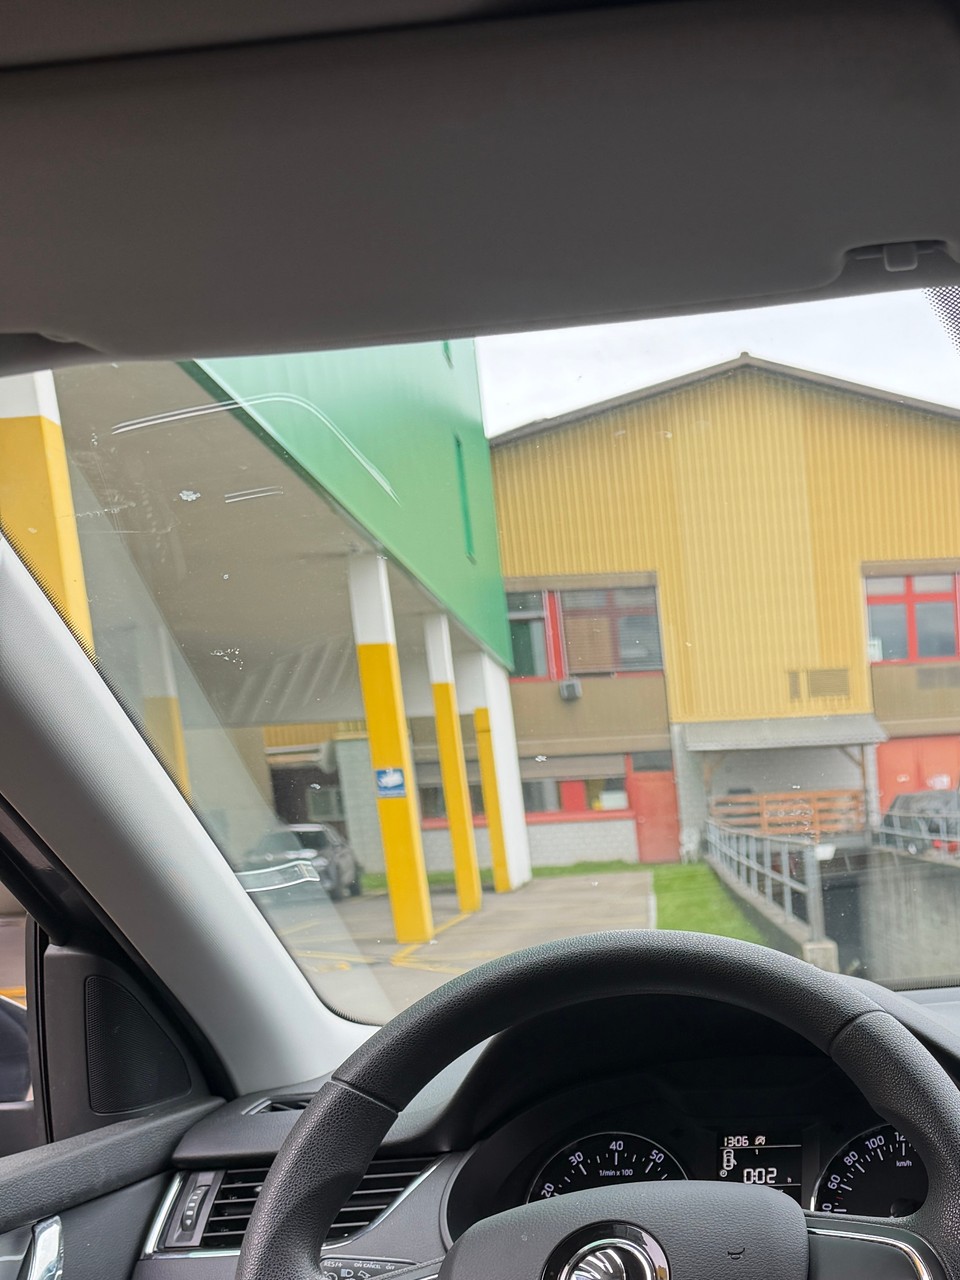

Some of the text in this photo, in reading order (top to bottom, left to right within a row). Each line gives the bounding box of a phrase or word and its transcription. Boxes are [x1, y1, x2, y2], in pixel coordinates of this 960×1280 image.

[609, 1140, 624, 1150] 40
[724, 1135, 749, 1147] 13:06
[865, 1135, 885, 1149] 100
[568, 1151, 584, 1166] 30
[649, 1149, 665, 1164] 50
[843, 1151, 859, 1166] 80
[743, 1167, 777, 1184] 0:02
[827, 1174, 841, 1190] 60
[540, 1182, 555, 1198] 20
